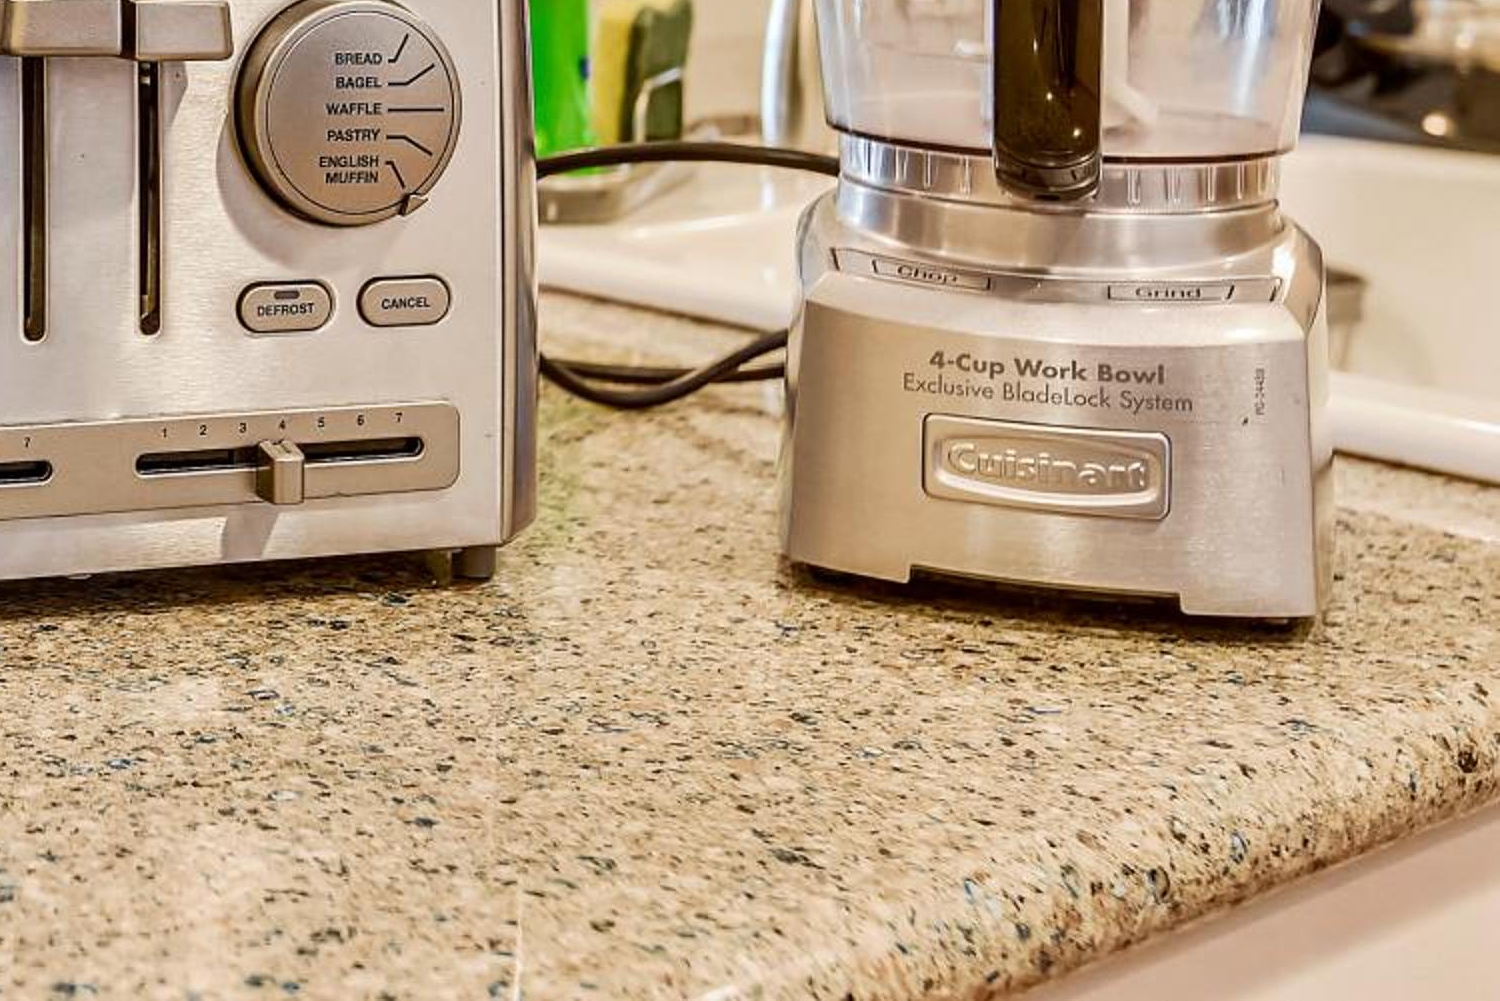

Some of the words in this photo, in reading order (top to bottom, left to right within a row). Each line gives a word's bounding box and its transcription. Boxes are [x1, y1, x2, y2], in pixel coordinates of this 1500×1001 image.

[335, 53, 382, 65] BREAD
[335, 77, 381, 89] BAGEL
[326, 103, 382, 115] WAFFLE
[327, 129, 380, 142] PASTRY
[319, 156, 378, 167] ENGLISH
[325, 172, 378, 184] MUFFIN
[1135, 286, 1201, 298] Grind
[381, 297, 430, 310] CANCEL
[257, 303, 315, 317] DEFROST
[929, 351, 1005, 379] 4-Cup
[1013, 358, 1087, 381] Work
[1098, 364, 1165, 385] Bowl
[903, 372, 994, 400] Exclusive
[1003, 382, 1110, 408] BladeLock
[1119, 390, 1193, 415] System
[162, 427, 168, 437] 1
[199, 424, 207, 436] 2
[238, 422, 246, 434] 3
[278, 419, 286, 431] 4
[317, 417, 325, 428] 5
[356, 414, 364, 426] 6
[395, 412, 403, 423] 7
[23, 437, 31, 448] 7
[948, 442, 1145, 489] Cuisinart
